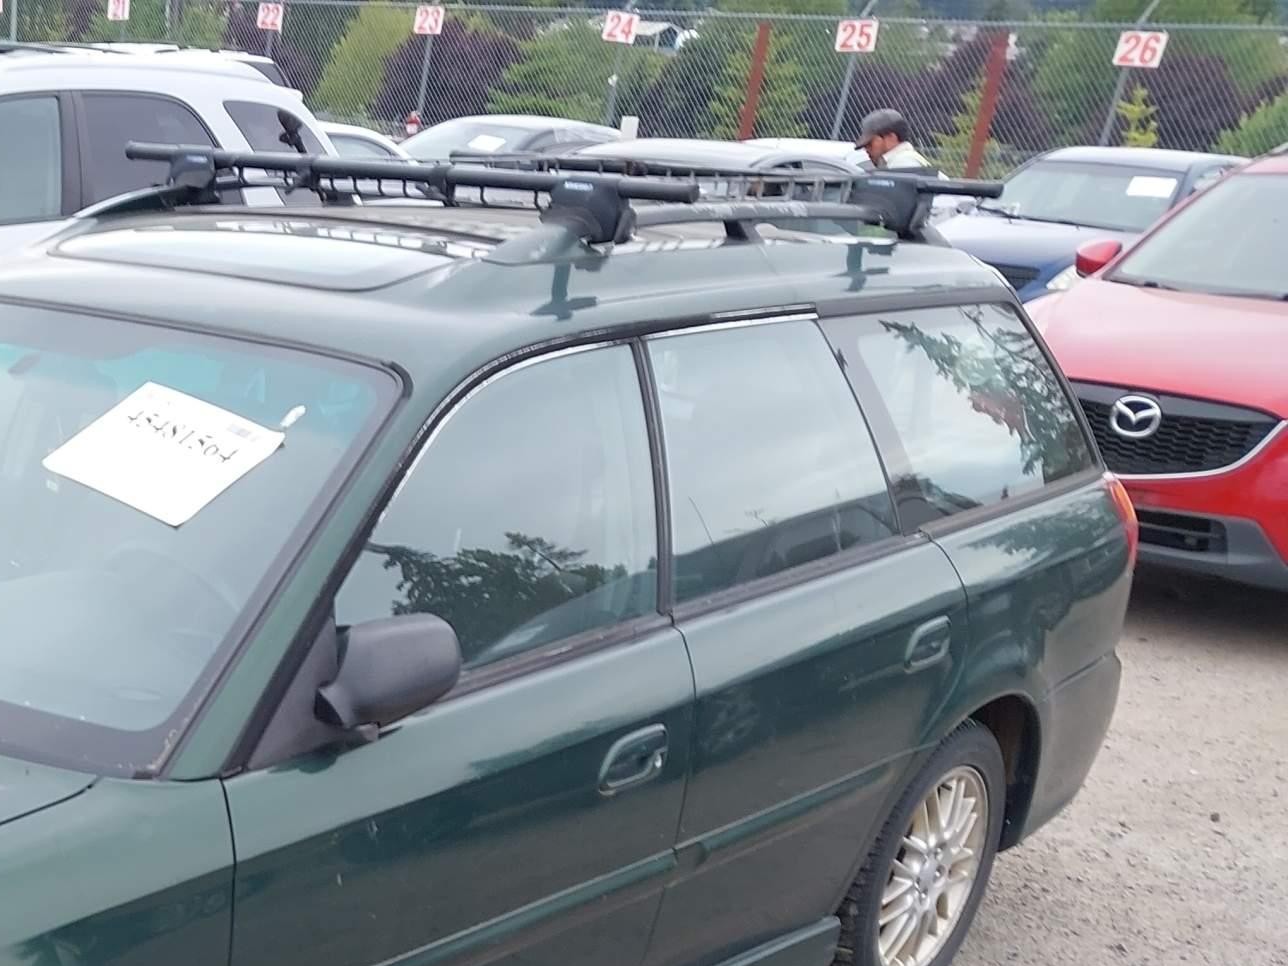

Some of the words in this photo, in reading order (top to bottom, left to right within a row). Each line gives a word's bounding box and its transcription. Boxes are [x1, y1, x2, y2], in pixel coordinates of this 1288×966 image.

[261, 4, 280, 26] 22
[417, 8, 441, 32] 23
[606, 14, 634, 40] 24
[840, 23, 873, 49] 25
[1118, 34, 1161, 65] 26
